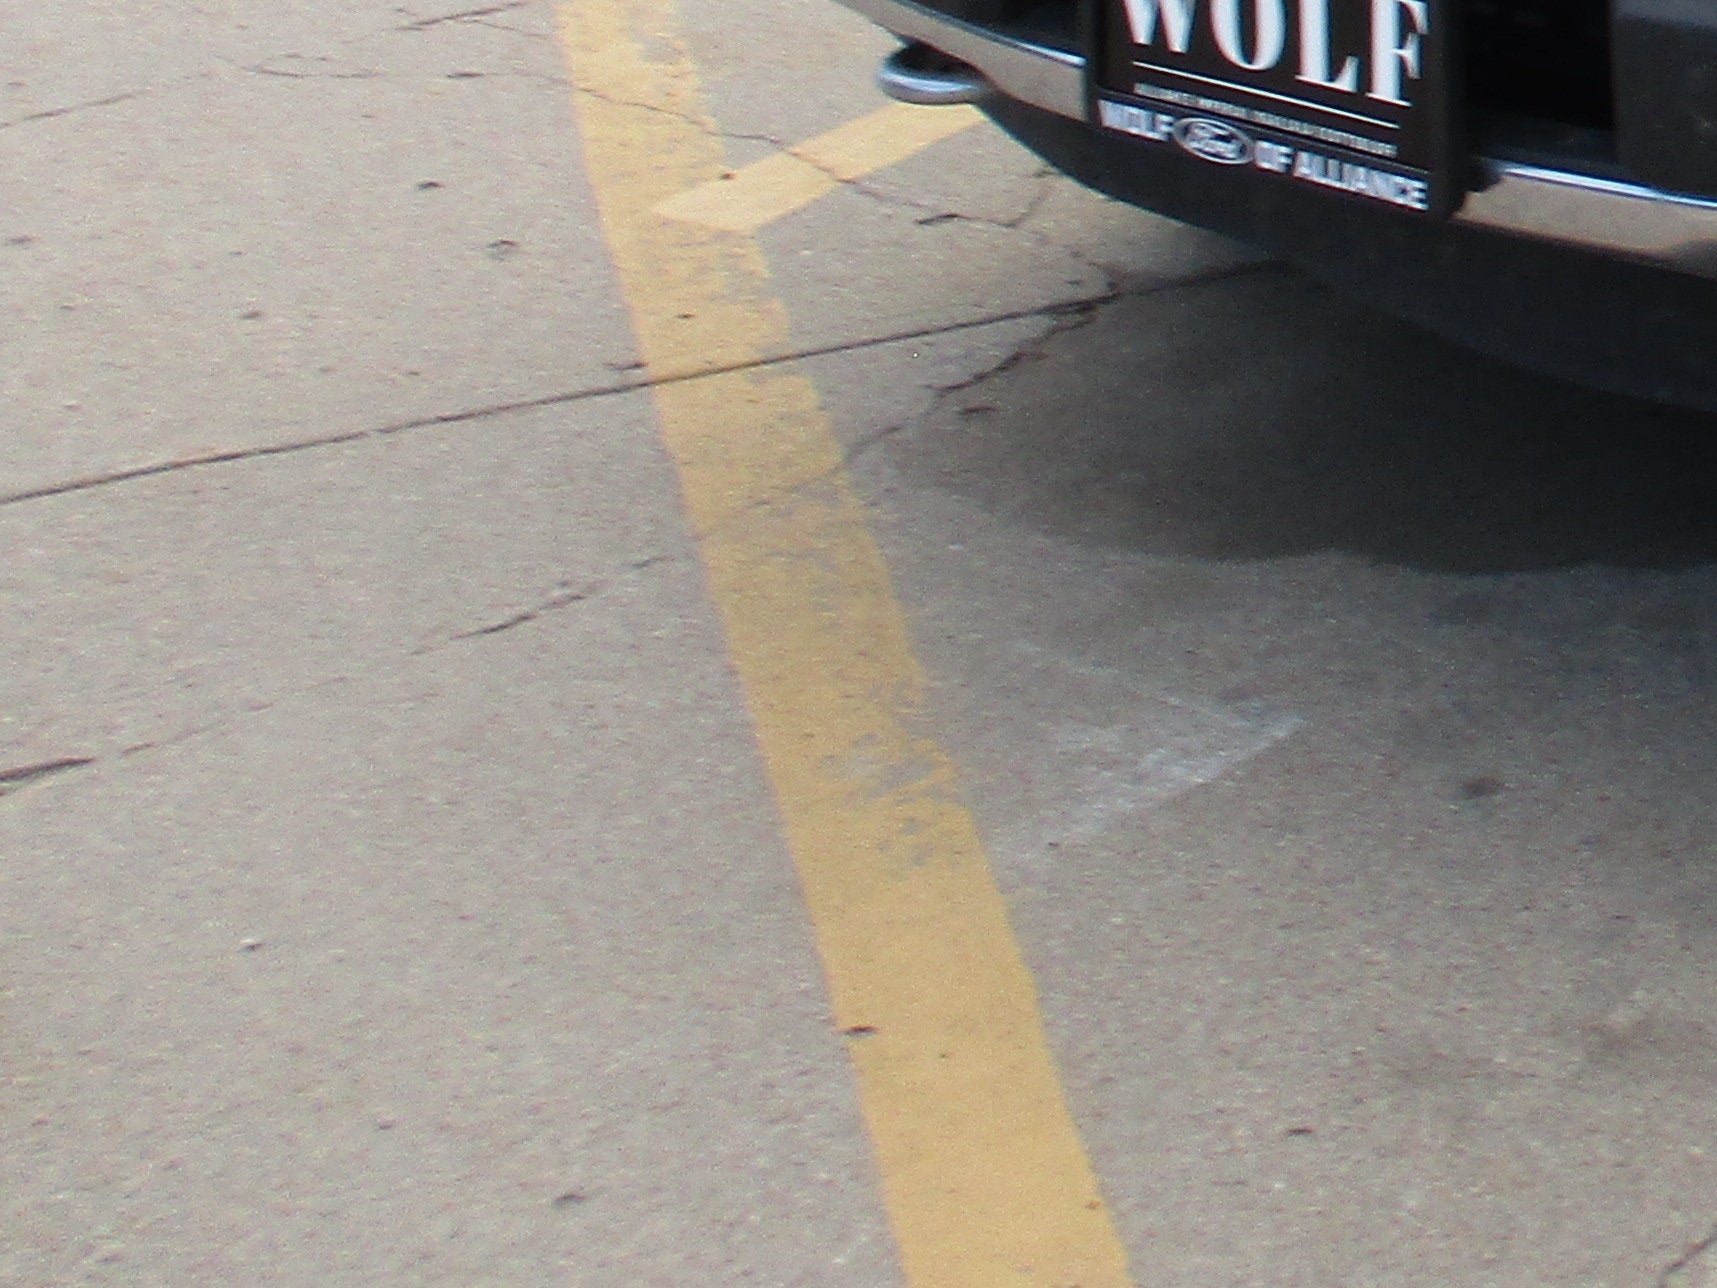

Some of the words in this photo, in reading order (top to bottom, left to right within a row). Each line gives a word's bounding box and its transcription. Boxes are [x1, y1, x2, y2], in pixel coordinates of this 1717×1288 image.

[1099, 98, 1175, 143] WOLF
[1255, 139, 1295, 173] OF
[1293, 148, 1430, 212] ALLIANCE
